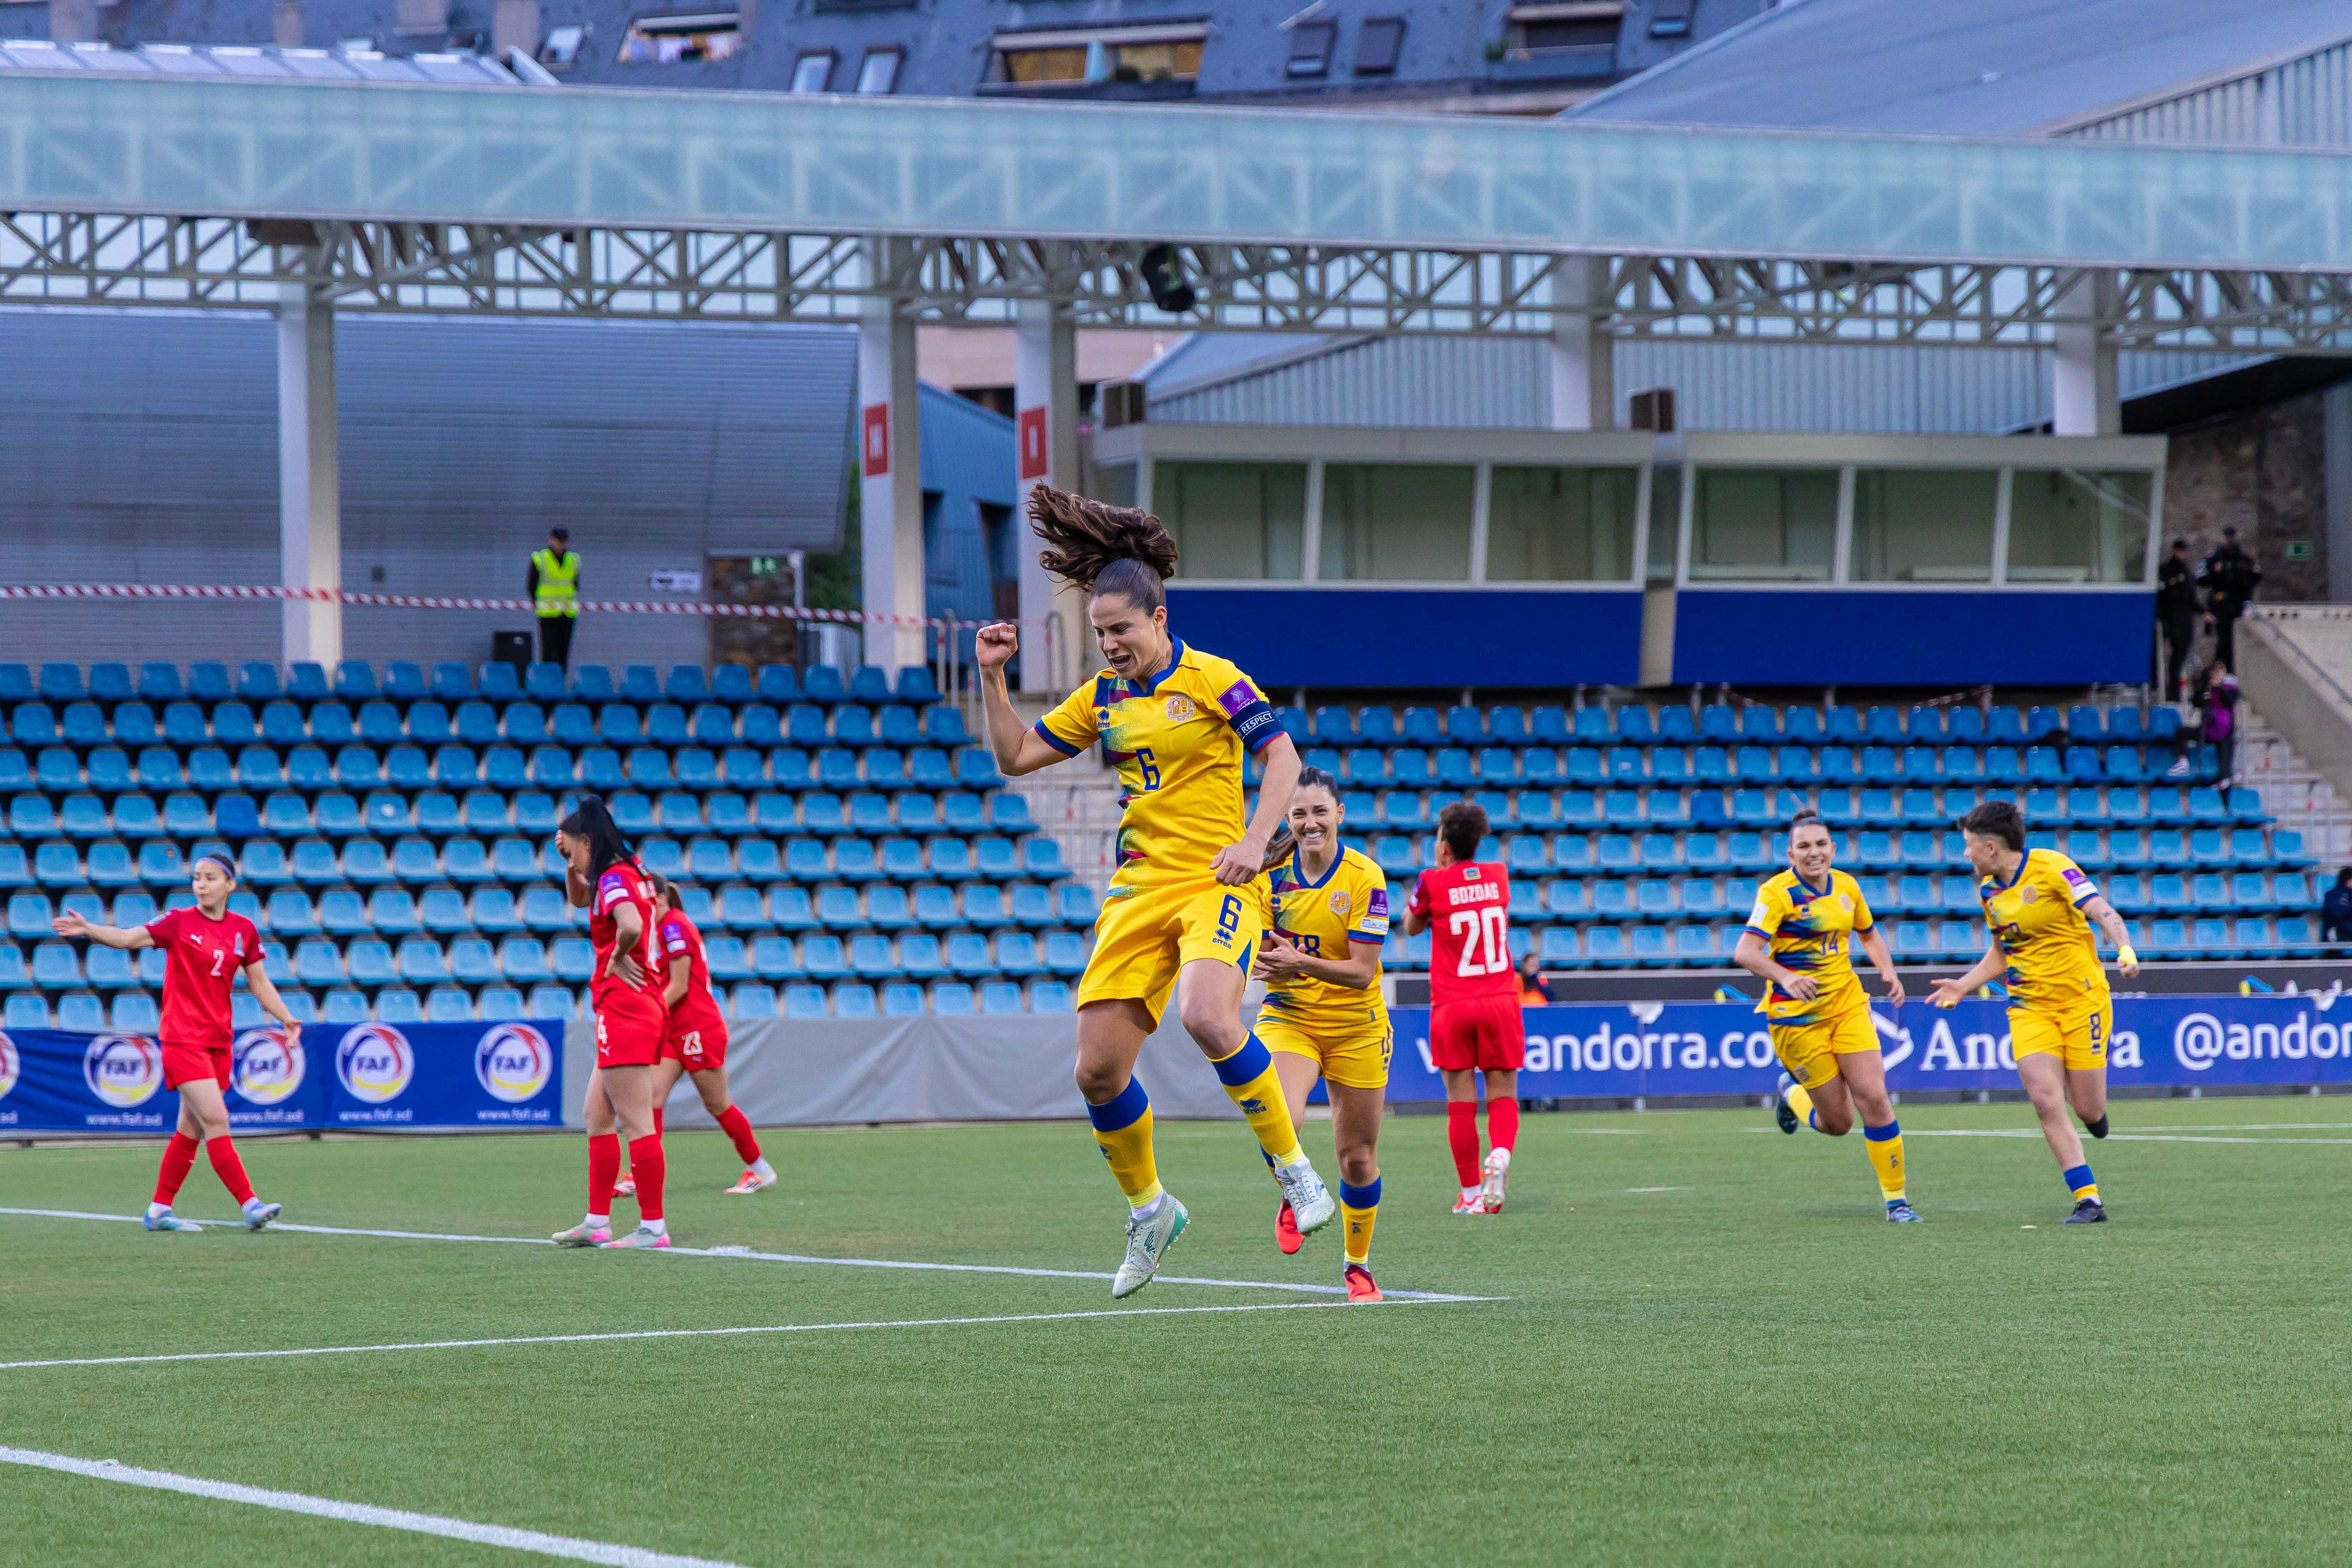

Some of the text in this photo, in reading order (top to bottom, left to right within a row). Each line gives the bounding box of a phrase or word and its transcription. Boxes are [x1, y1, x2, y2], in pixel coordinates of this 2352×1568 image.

[1241, 713, 1272, 733] RESPECT
[1136, 748, 1160, 790] 6
[1219, 894, 1242, 932] 6
[1449, 906, 1509, 977] 20
[1822, 930, 1838, 955] 14
[210, 949, 224, 977] 2
[597, 1014, 608, 1044] 4
[2090, 1013, 2101, 1041] 8
[106, 1059, 142, 1075] FAF
[357, 1056, 390, 1072] FAF
[495, 1055, 530, 1072] FAF
